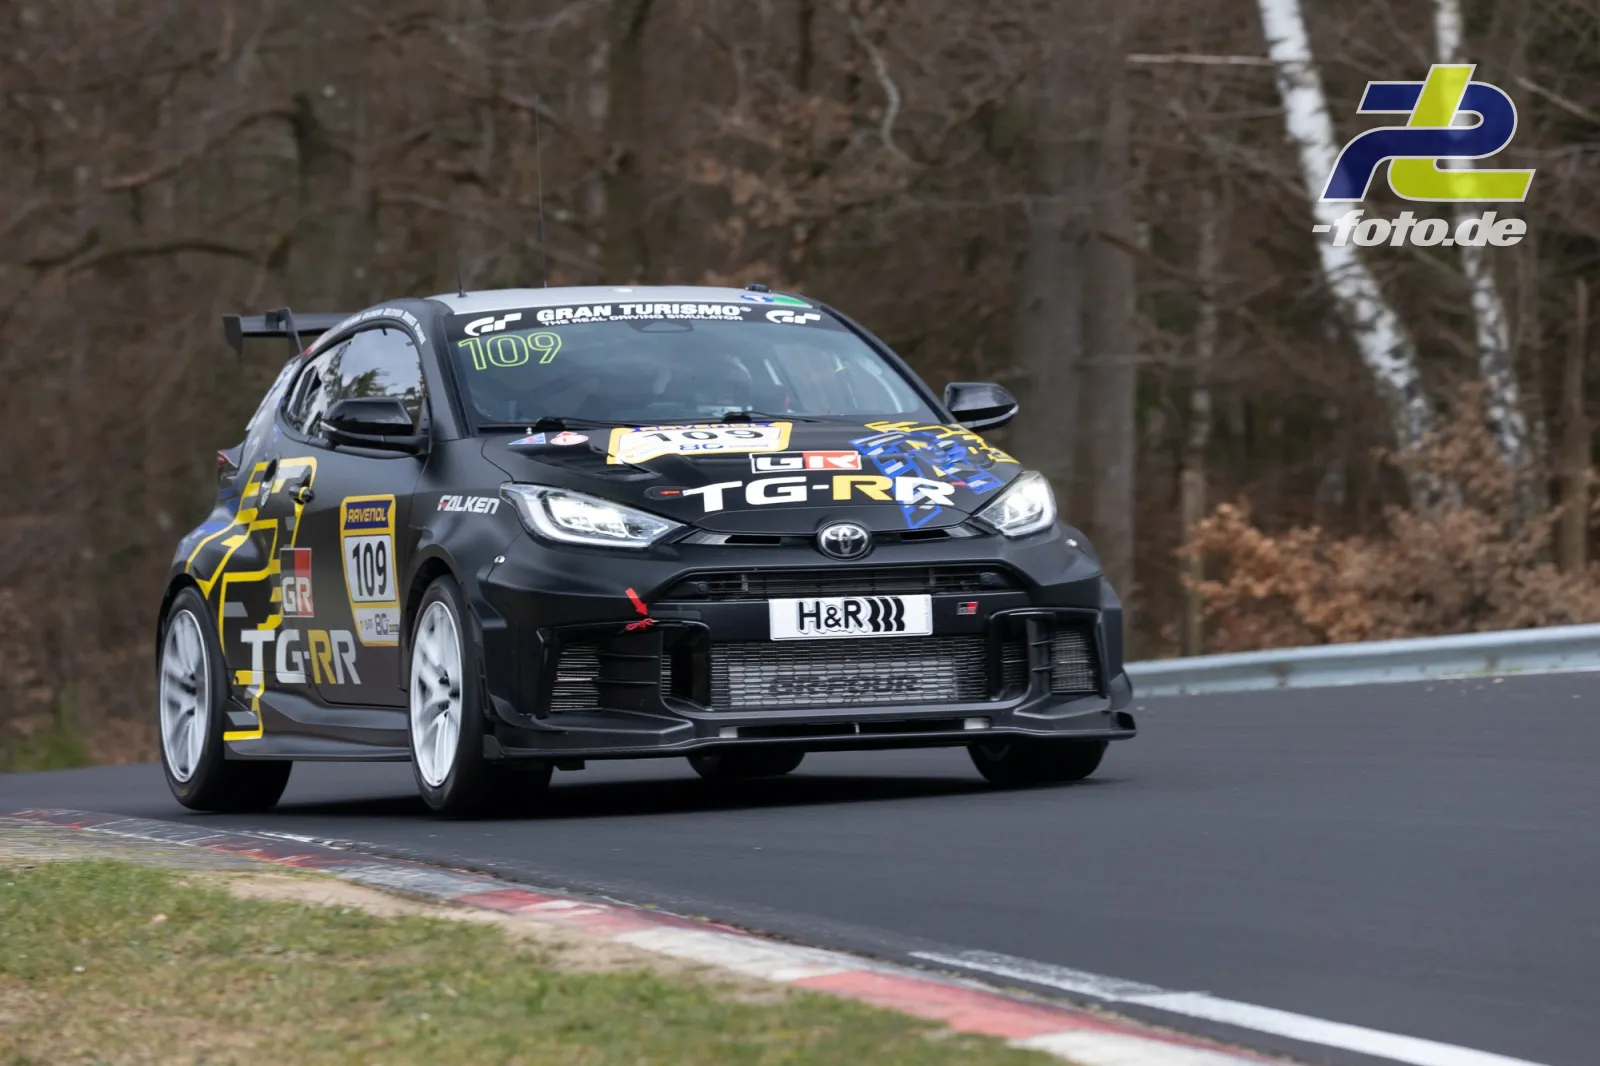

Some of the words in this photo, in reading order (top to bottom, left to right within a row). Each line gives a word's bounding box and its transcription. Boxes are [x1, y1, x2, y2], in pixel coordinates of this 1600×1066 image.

[536, 304, 612, 323] GRAN
[618, 303, 742, 317] TURISMO
[571, 316, 608, 325] REAL
[608, 314, 664, 322] DRIVING
[666, 314, 744, 322] SIMULATOR
[458, 331, 562, 371] 109
[643, 428, 764, 442] 109
[755, 452, 858, 470] GR
[437, 494, 500, 515] FALKEN
[682, 474, 955, 513] TG-RR
[347, 507, 387, 523] RAVENOL
[352, 540, 388, 597] 109
[281, 576, 312, 613] GR
[798, 599, 865, 632] H&R
[240, 629, 362, 685] TG-RR
